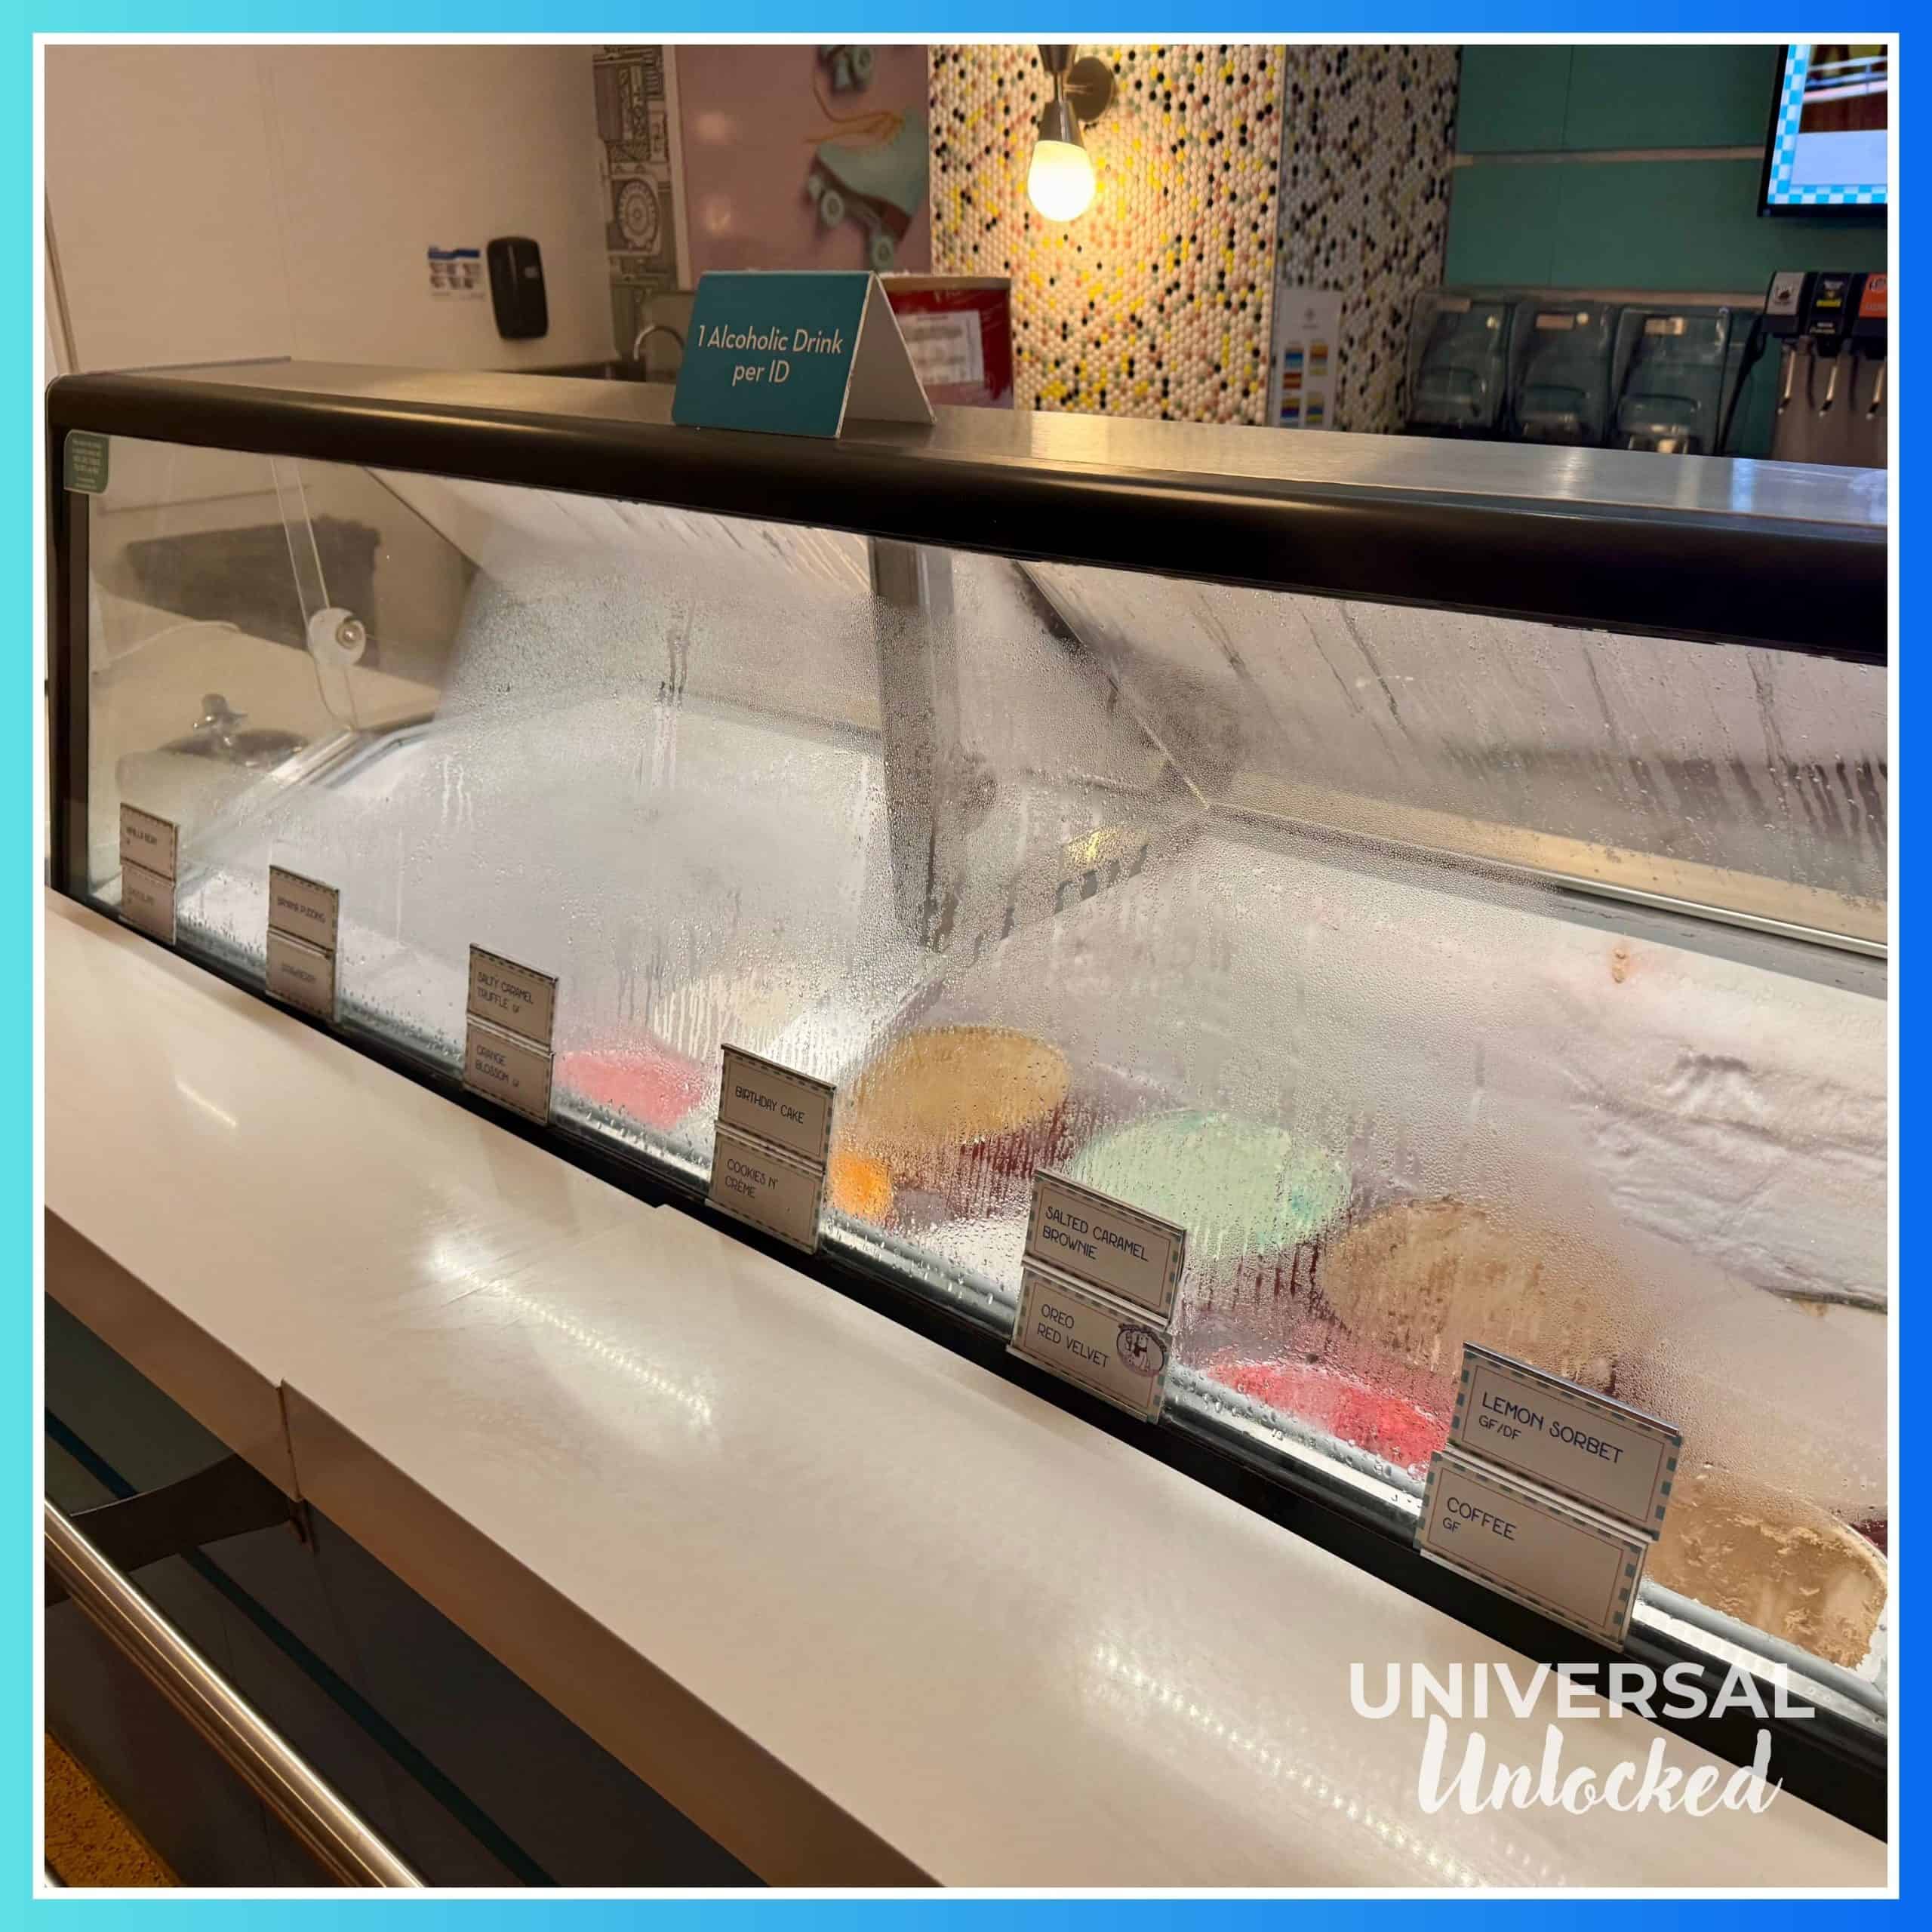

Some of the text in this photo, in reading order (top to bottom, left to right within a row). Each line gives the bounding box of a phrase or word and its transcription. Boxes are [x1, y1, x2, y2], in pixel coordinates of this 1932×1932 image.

[698, 324, 844, 355] 1 Alcoholic Drink
[732, 360, 789, 386] per ID
[477, 972, 534, 1005] SALTY CARAMEL
[477, 986, 508, 1010] TRUFFLE
[476, 1044, 506, 1066] ORANGE
[475, 1060, 509, 1084] BLOSSOM
[735, 1085, 805, 1124] BIRTHDAY CAKE
[727, 1158, 767, 1185] COOKIES
[1042, 1226, 1099, 1260] BROWNIE
[1045, 1206, 1149, 1263] SALTED CARAMEL
[1041, 1303, 1075, 1330] OREO
[1036, 1322, 1110, 1367] RED VELVET
[1478, 1414, 1522, 1441] GF/DF
[1482, 1391, 1625, 1466] LEMON SORBET
[1442, 1518, 1462, 1534] GF
[1447, 1497, 1517, 1541] COFFEE
